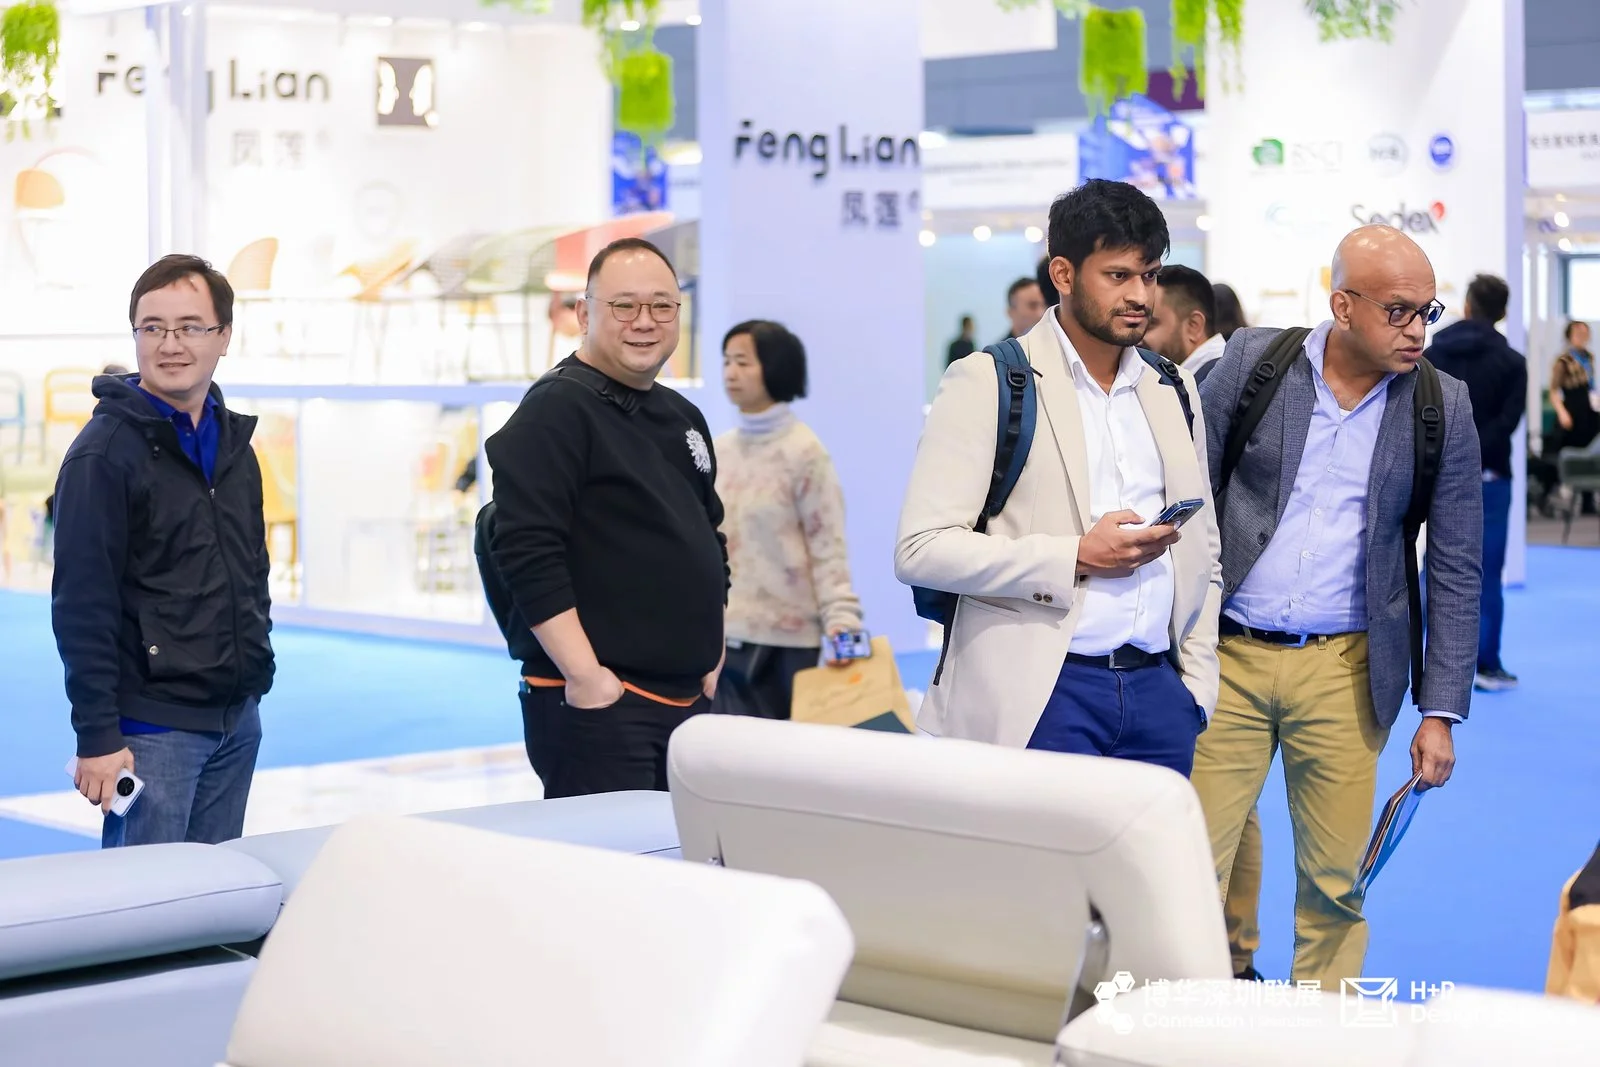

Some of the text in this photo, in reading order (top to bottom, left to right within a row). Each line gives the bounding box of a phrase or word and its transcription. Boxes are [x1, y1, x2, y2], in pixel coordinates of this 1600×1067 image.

[229, 58, 330, 101] Lian
[734, 119, 919, 179] Feng Lian
